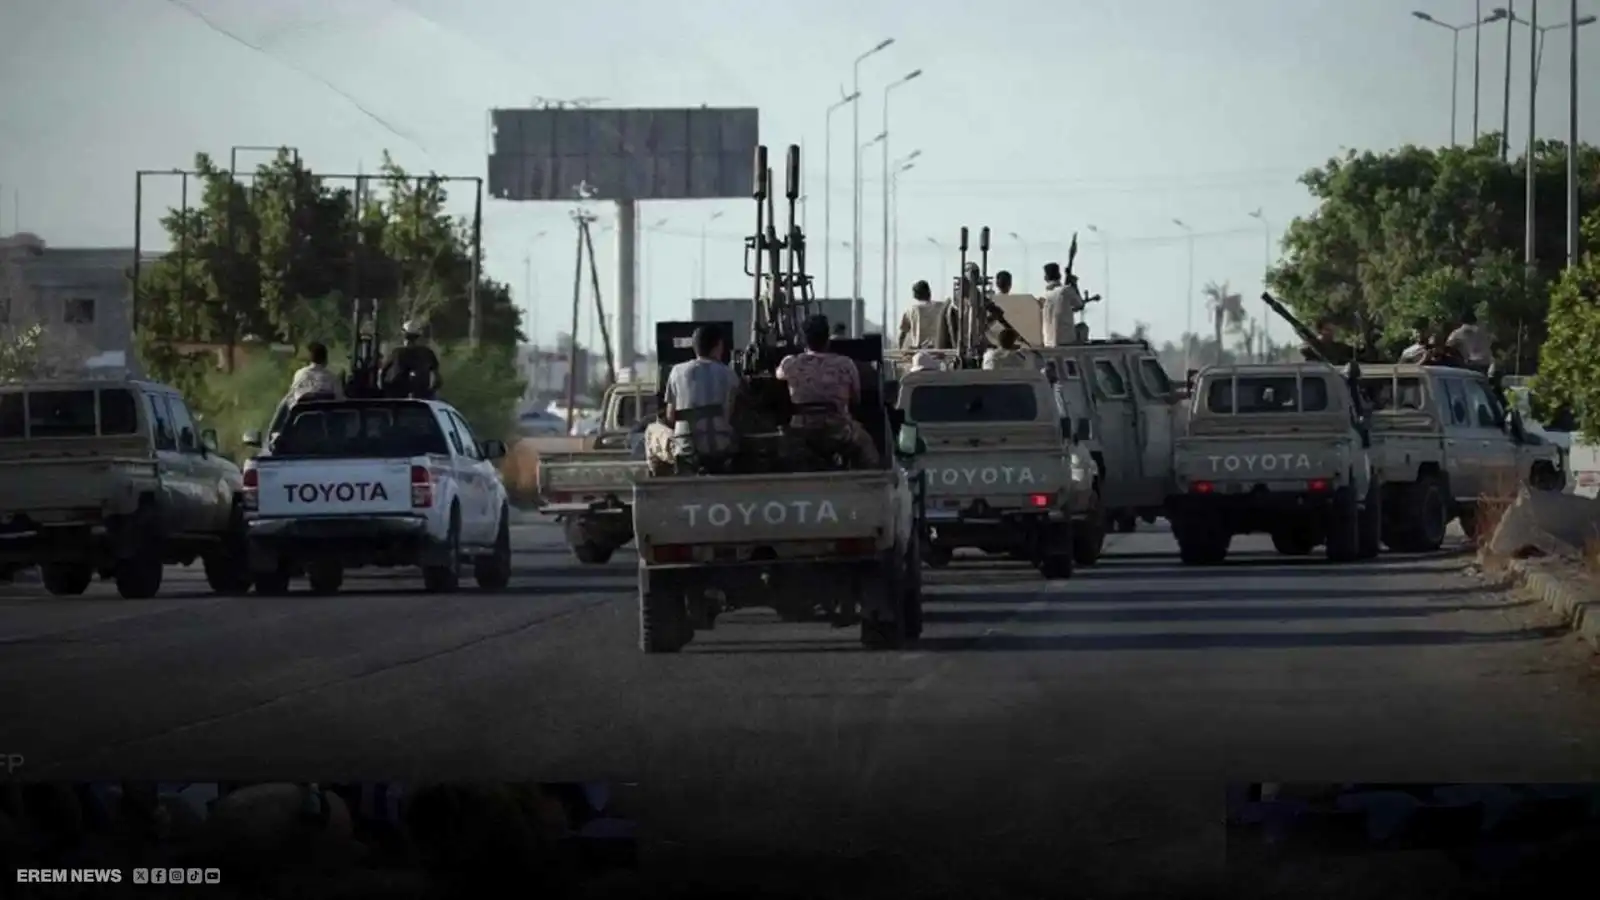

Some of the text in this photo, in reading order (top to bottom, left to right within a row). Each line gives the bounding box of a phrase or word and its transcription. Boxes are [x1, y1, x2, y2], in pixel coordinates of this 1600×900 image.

[1210, 455, 1310, 473] TOYOTA
[926, 466, 1035, 487] TOYOTA
[284, 481, 388, 504] TOYOTA
[683, 499, 838, 527] TOYOTA
